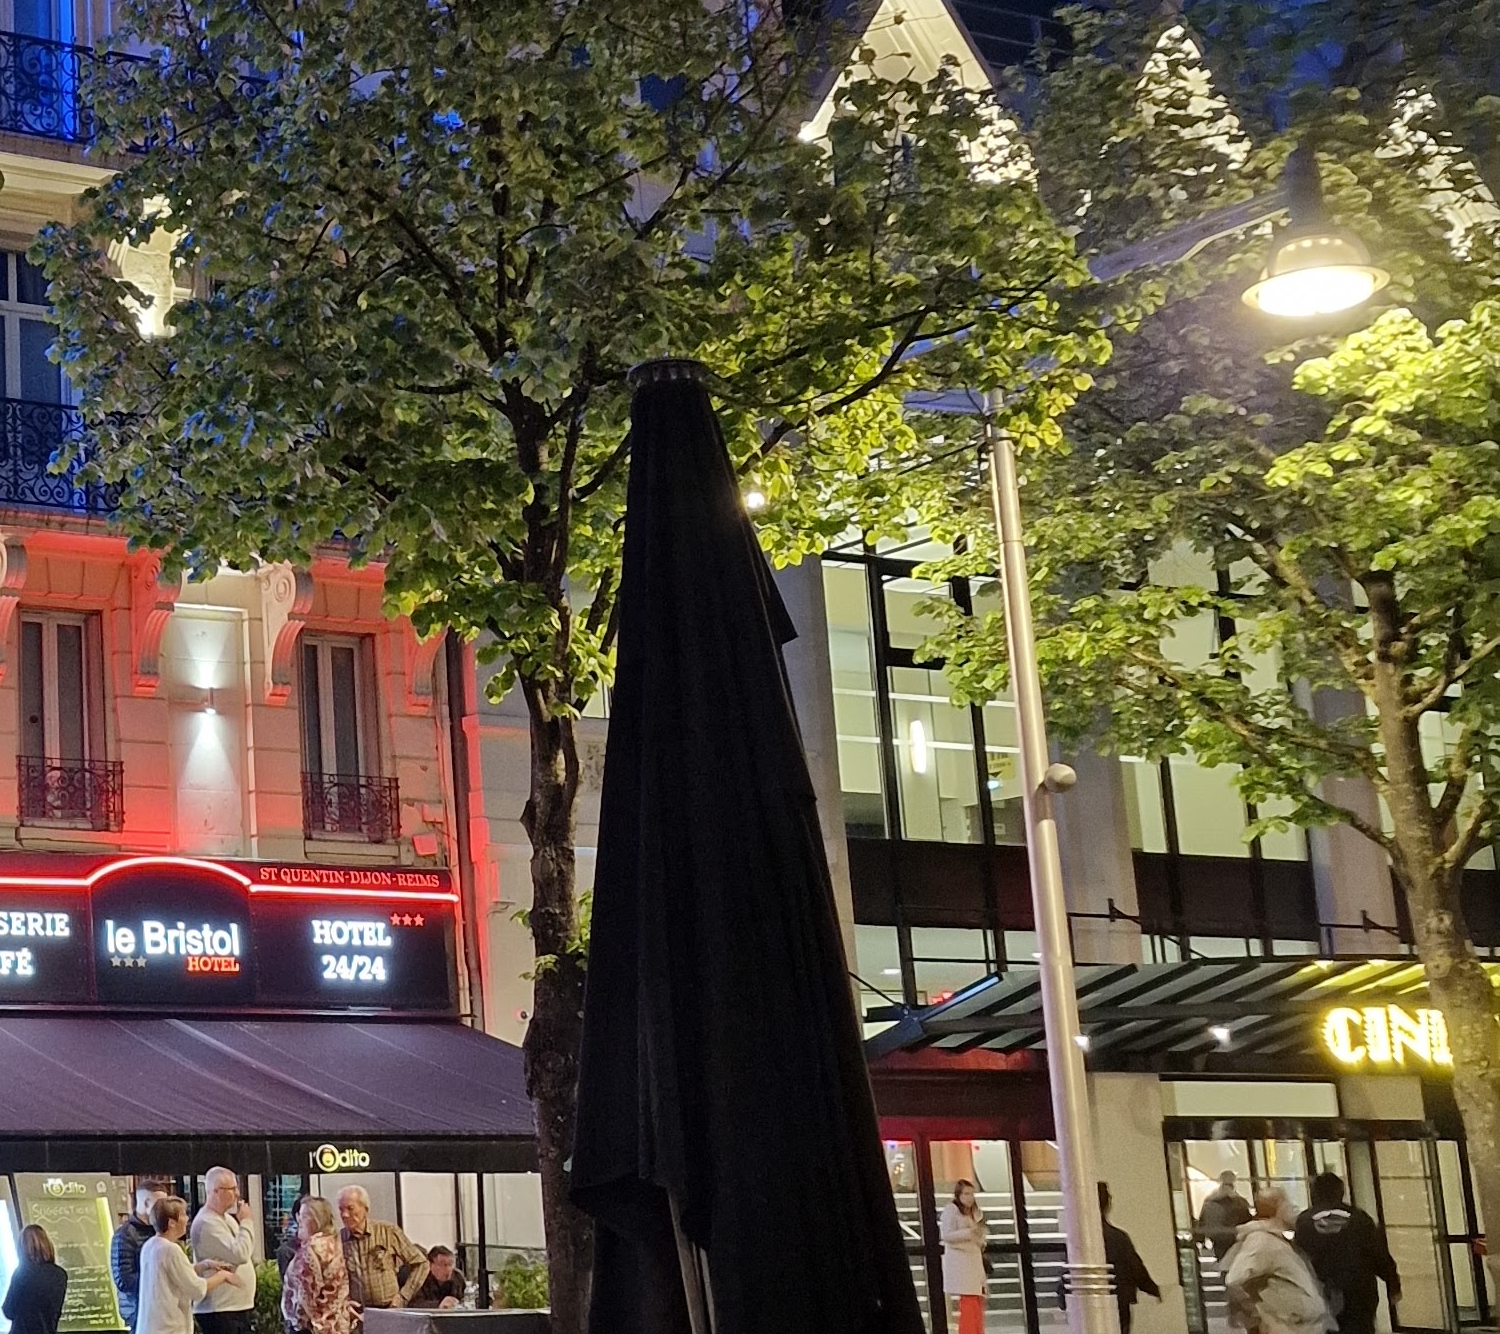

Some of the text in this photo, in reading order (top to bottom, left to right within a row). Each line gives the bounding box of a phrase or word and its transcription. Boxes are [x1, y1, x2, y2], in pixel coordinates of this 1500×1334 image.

[260, 868, 440, 888] ST QUENTIN-DIJON-REIMS
[105, 920, 240, 957] le Bristol
[311, 919, 392, 947] HOTEL
[187, 956, 240, 973] HOTEL
[321, 954, 386, 981] 24/24
